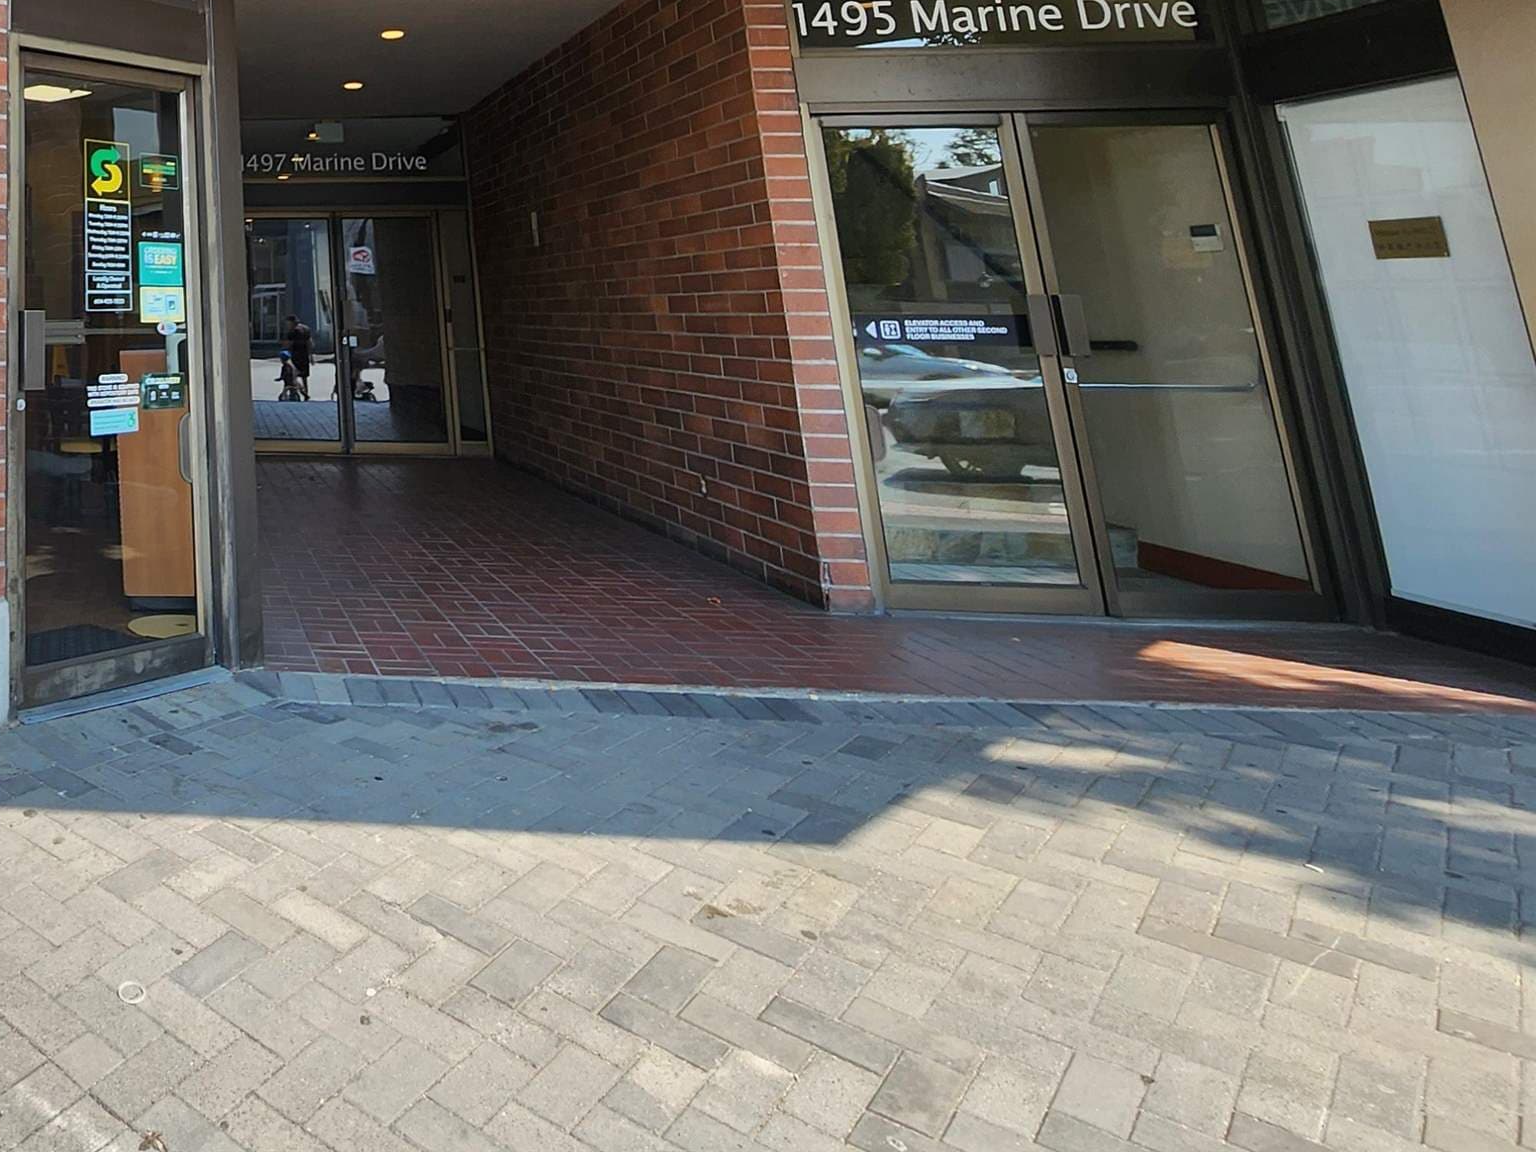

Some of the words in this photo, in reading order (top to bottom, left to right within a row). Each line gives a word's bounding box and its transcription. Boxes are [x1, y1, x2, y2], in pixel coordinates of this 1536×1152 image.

[792, 1, 897, 36] 1495
[294, 152, 365, 171] Marine
[372, 152, 427, 171] Drive
